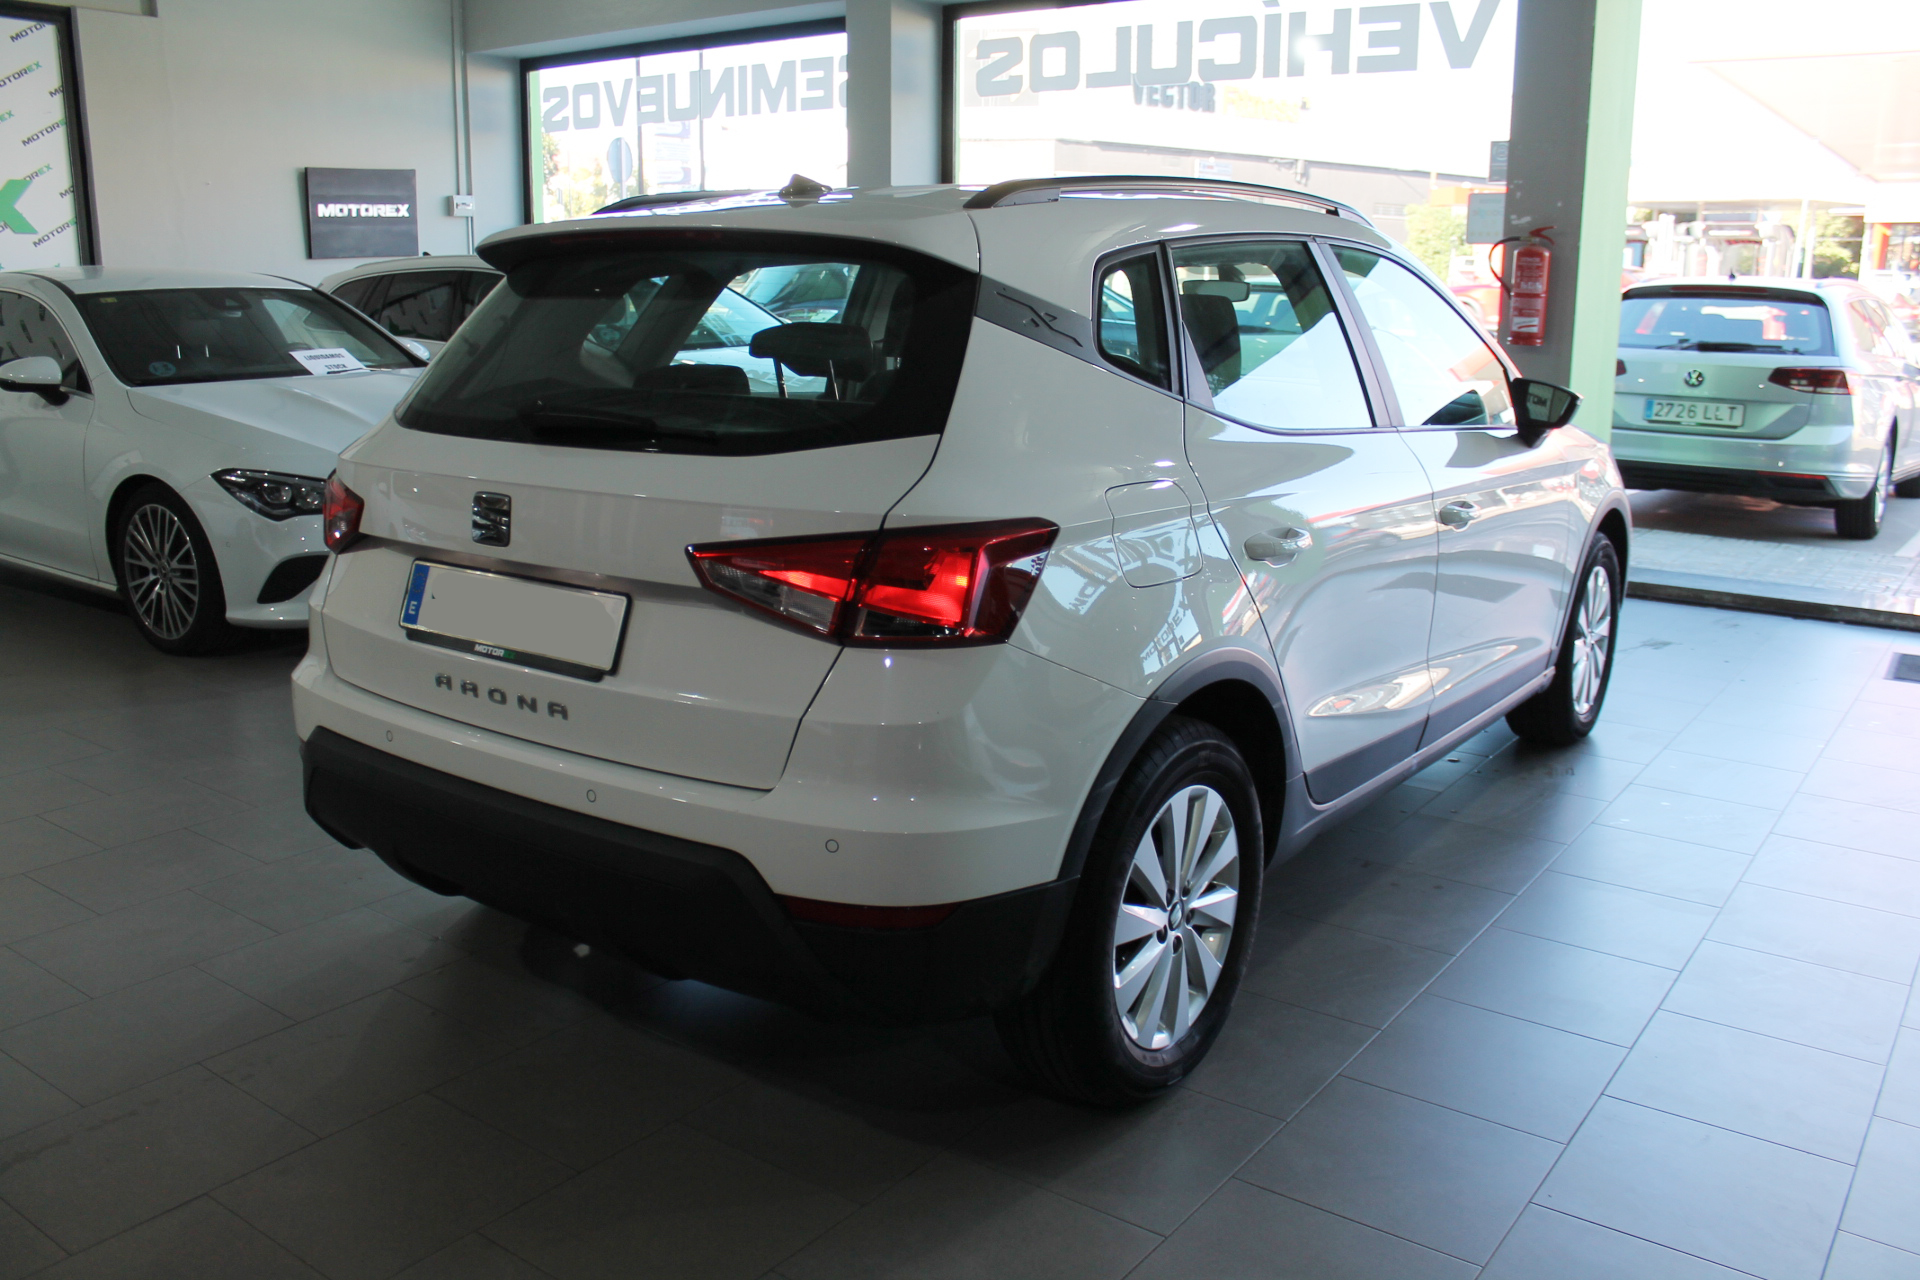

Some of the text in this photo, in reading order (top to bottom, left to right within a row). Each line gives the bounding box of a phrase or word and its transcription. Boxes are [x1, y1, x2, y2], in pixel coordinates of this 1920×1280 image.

[1132, 74, 1216, 113] VECTOR
[317, 203, 410, 218] MOTOREX
[1654, 402, 1737, 422] 2726 LLT
[408, 600, 418, 615] E
[434, 672, 569, 721] ARONA
